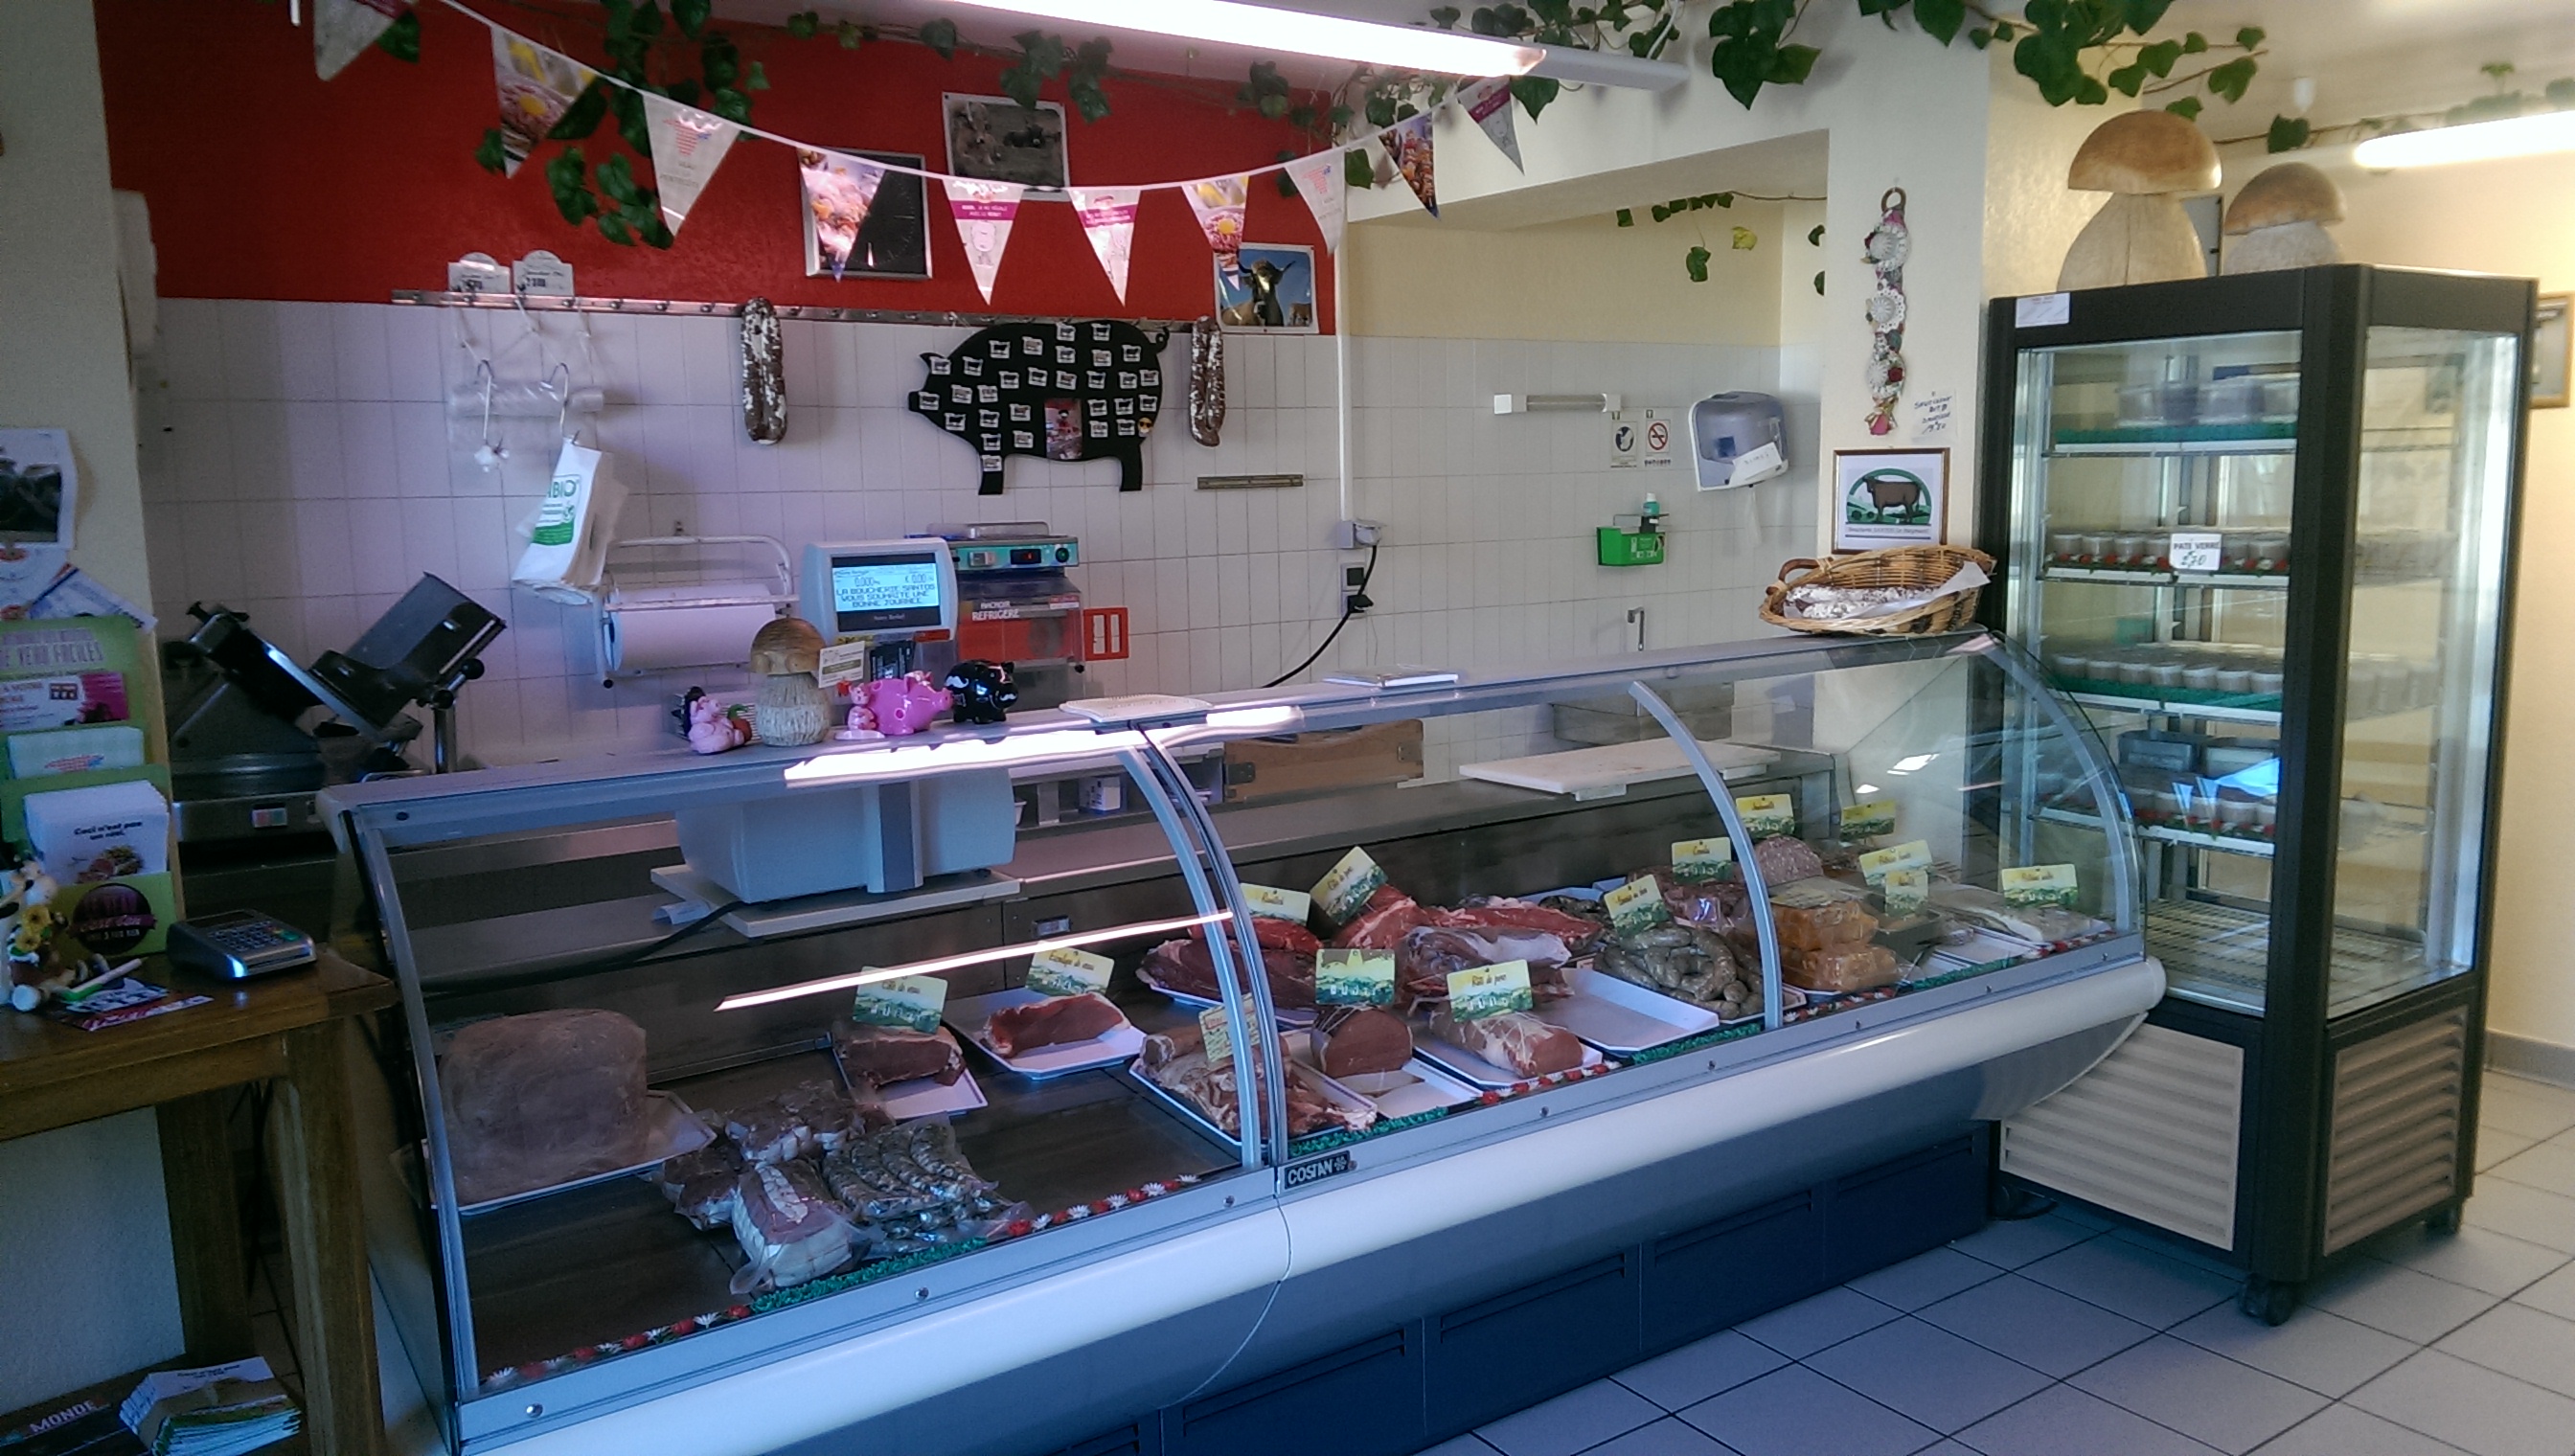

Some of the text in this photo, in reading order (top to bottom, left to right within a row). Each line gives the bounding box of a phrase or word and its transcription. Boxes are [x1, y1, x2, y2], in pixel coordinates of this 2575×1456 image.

[840, 594, 865, 603] VOUS
[850, 585, 899, 595] BOUCHERIE
[901, 582, 935, 591] SANTOS
[1288, 1158, 1335, 1186] COSTAN
[30, 1399, 97, 1433] MONDE
